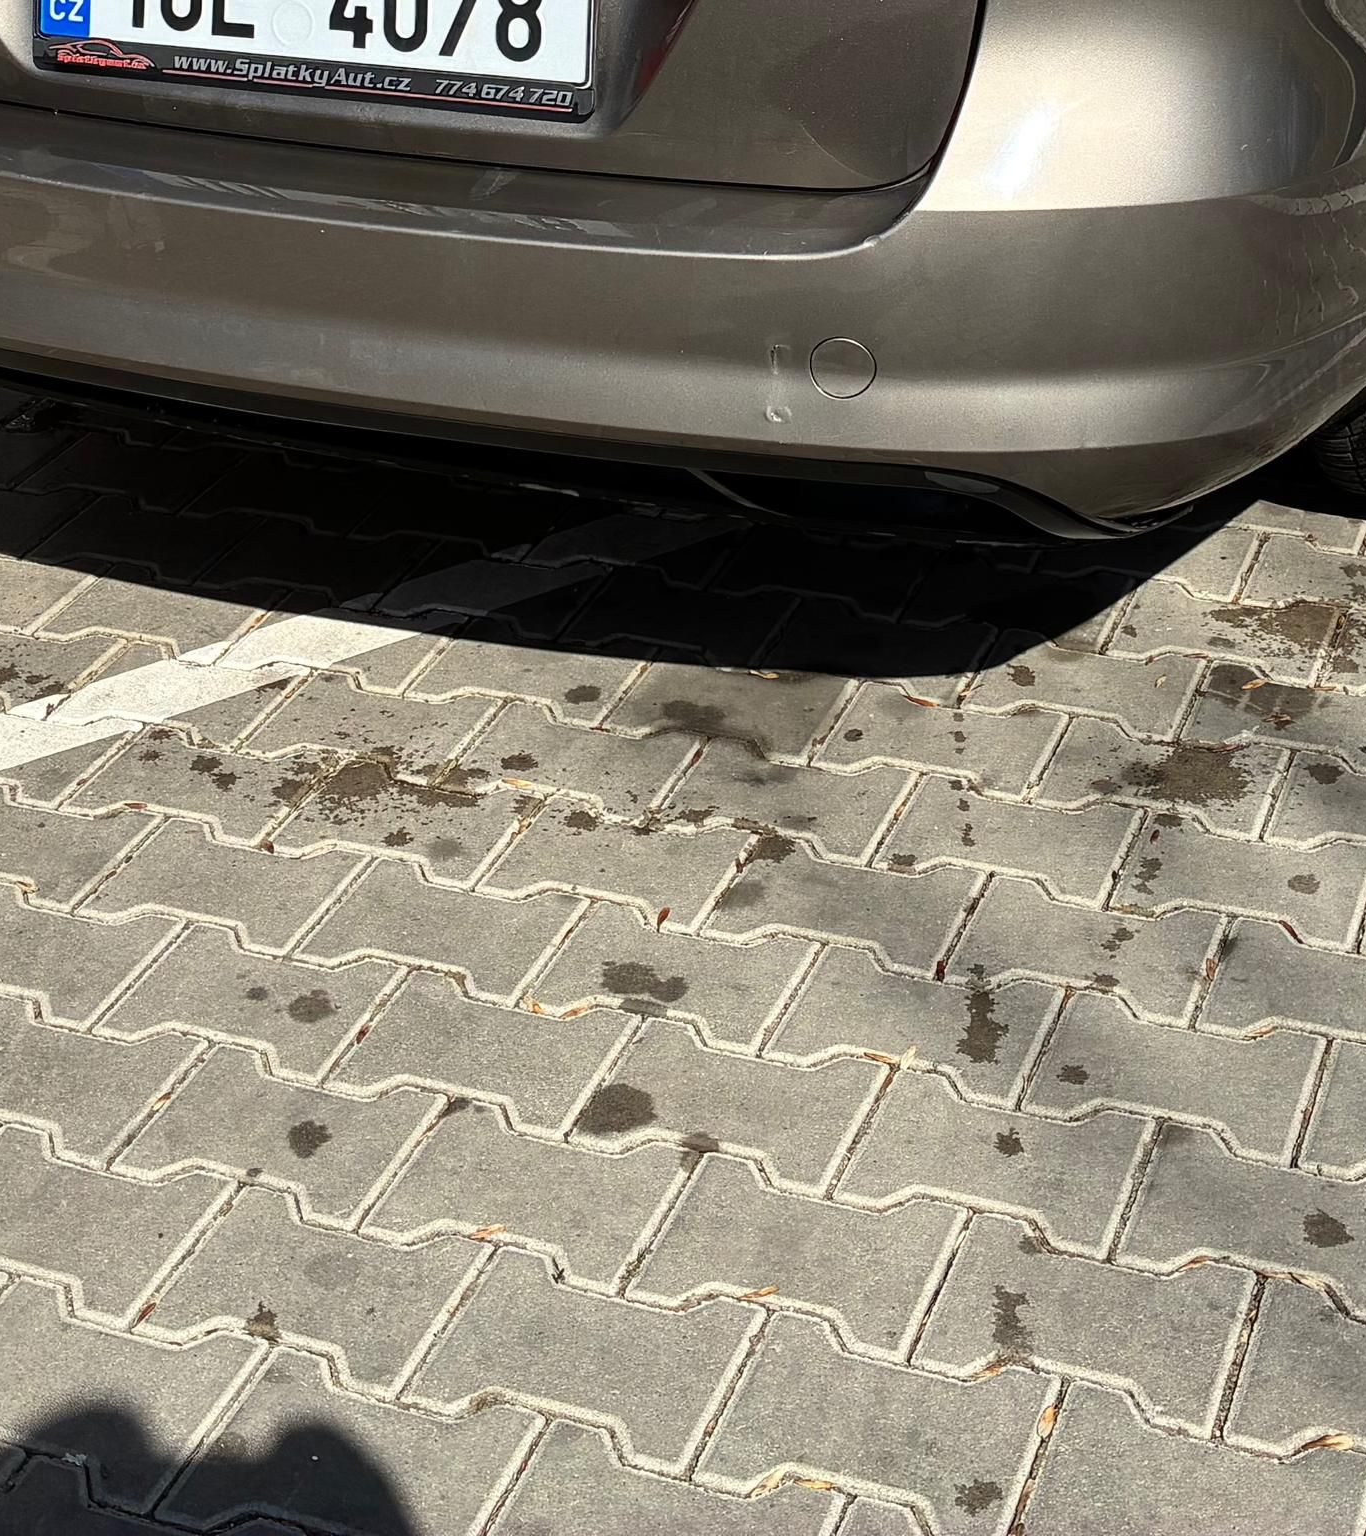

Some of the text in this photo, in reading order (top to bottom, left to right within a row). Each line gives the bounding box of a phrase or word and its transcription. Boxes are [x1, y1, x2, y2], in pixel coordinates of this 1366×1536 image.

[174, 55, 574, 107] www.SplatkyAut.cz 774 674 720
